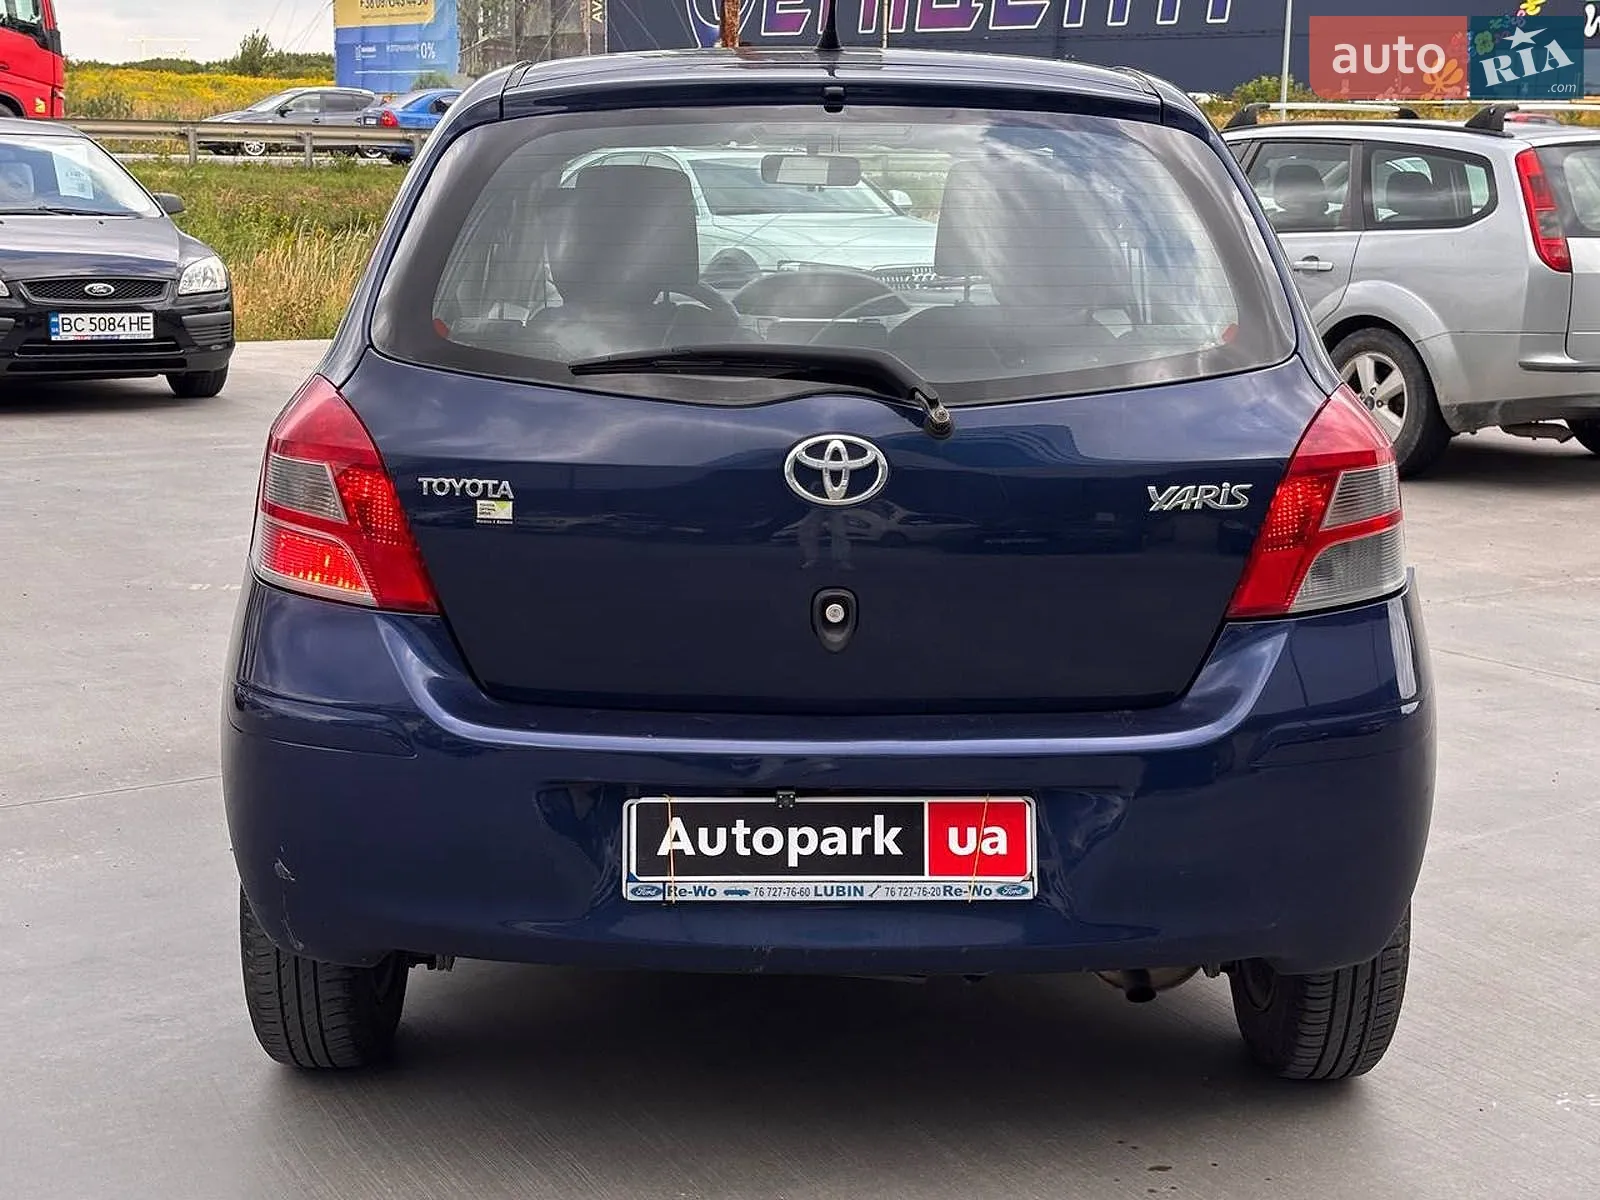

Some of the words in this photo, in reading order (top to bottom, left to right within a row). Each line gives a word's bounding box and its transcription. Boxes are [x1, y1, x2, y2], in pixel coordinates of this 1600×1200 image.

[61, 317, 85, 332] BC
[89, 317, 126, 332] 5084
[129, 316, 151, 331] HE
[417, 477, 515, 499] TOYOTA
[656, 814, 904, 867] Autopark
[947, 824, 1008, 856] ua
[753, 886, 765, 897] 76
[814, 885, 865, 897] LUBIN
[884, 886, 896, 897] 76
